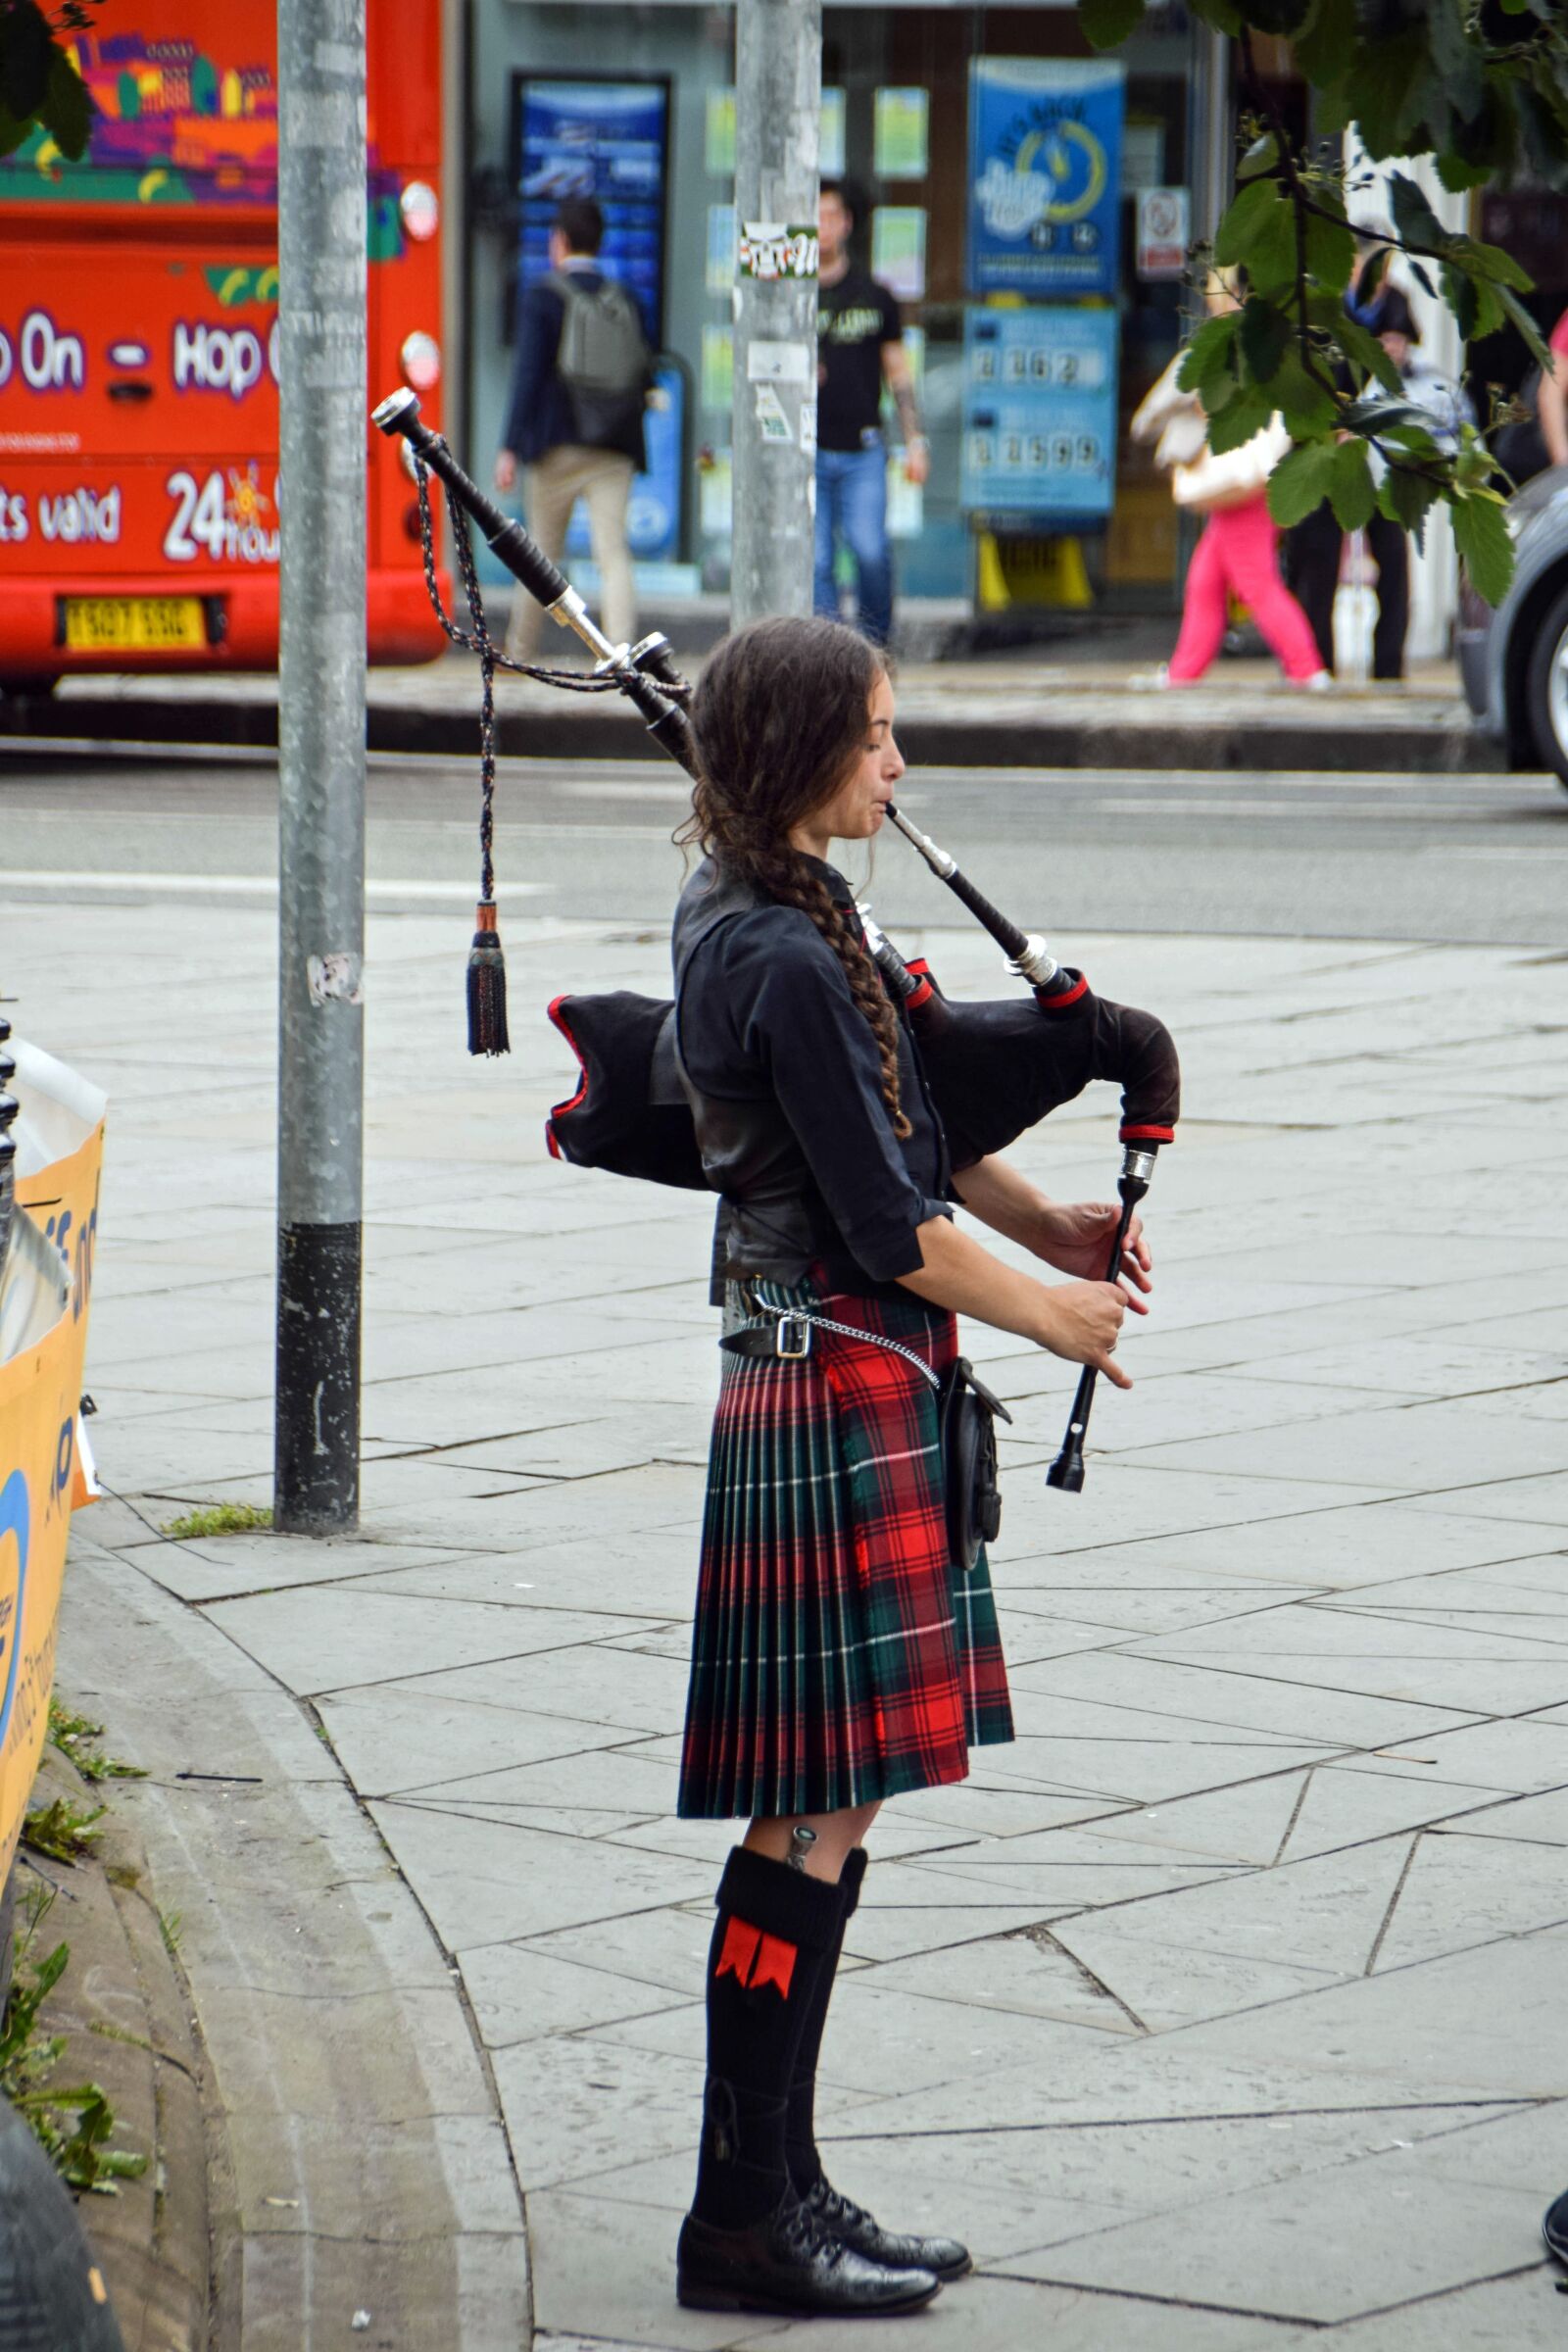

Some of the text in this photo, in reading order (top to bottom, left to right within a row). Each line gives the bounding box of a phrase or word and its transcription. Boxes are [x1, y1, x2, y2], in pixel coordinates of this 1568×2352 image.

[20, 311, 84, 390] On
[172, 320, 263, 399] Hop
[37, 483, 122, 543] valid
[163, 468, 226, 562] 24
